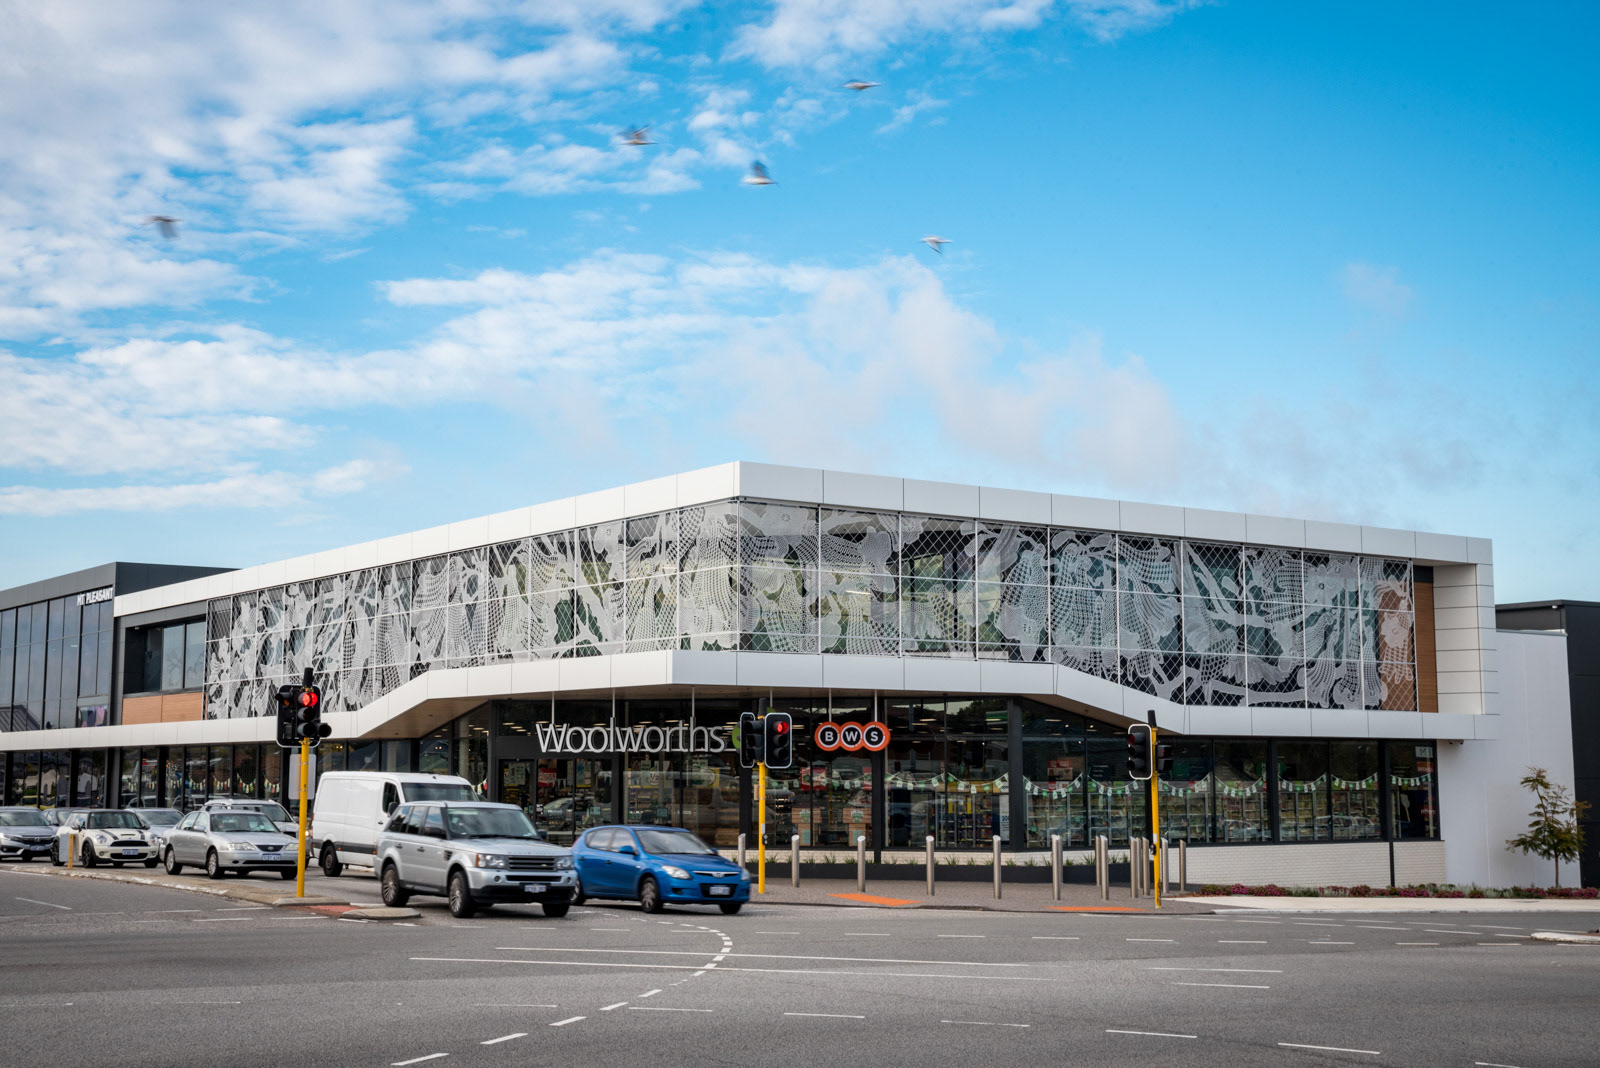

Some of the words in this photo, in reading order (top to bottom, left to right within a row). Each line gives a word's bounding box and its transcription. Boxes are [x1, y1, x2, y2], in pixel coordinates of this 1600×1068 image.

[86, 587, 114, 604] PLEASANT
[535, 717, 726, 753] Woolworths
[824, 731, 879, 742] BWS
